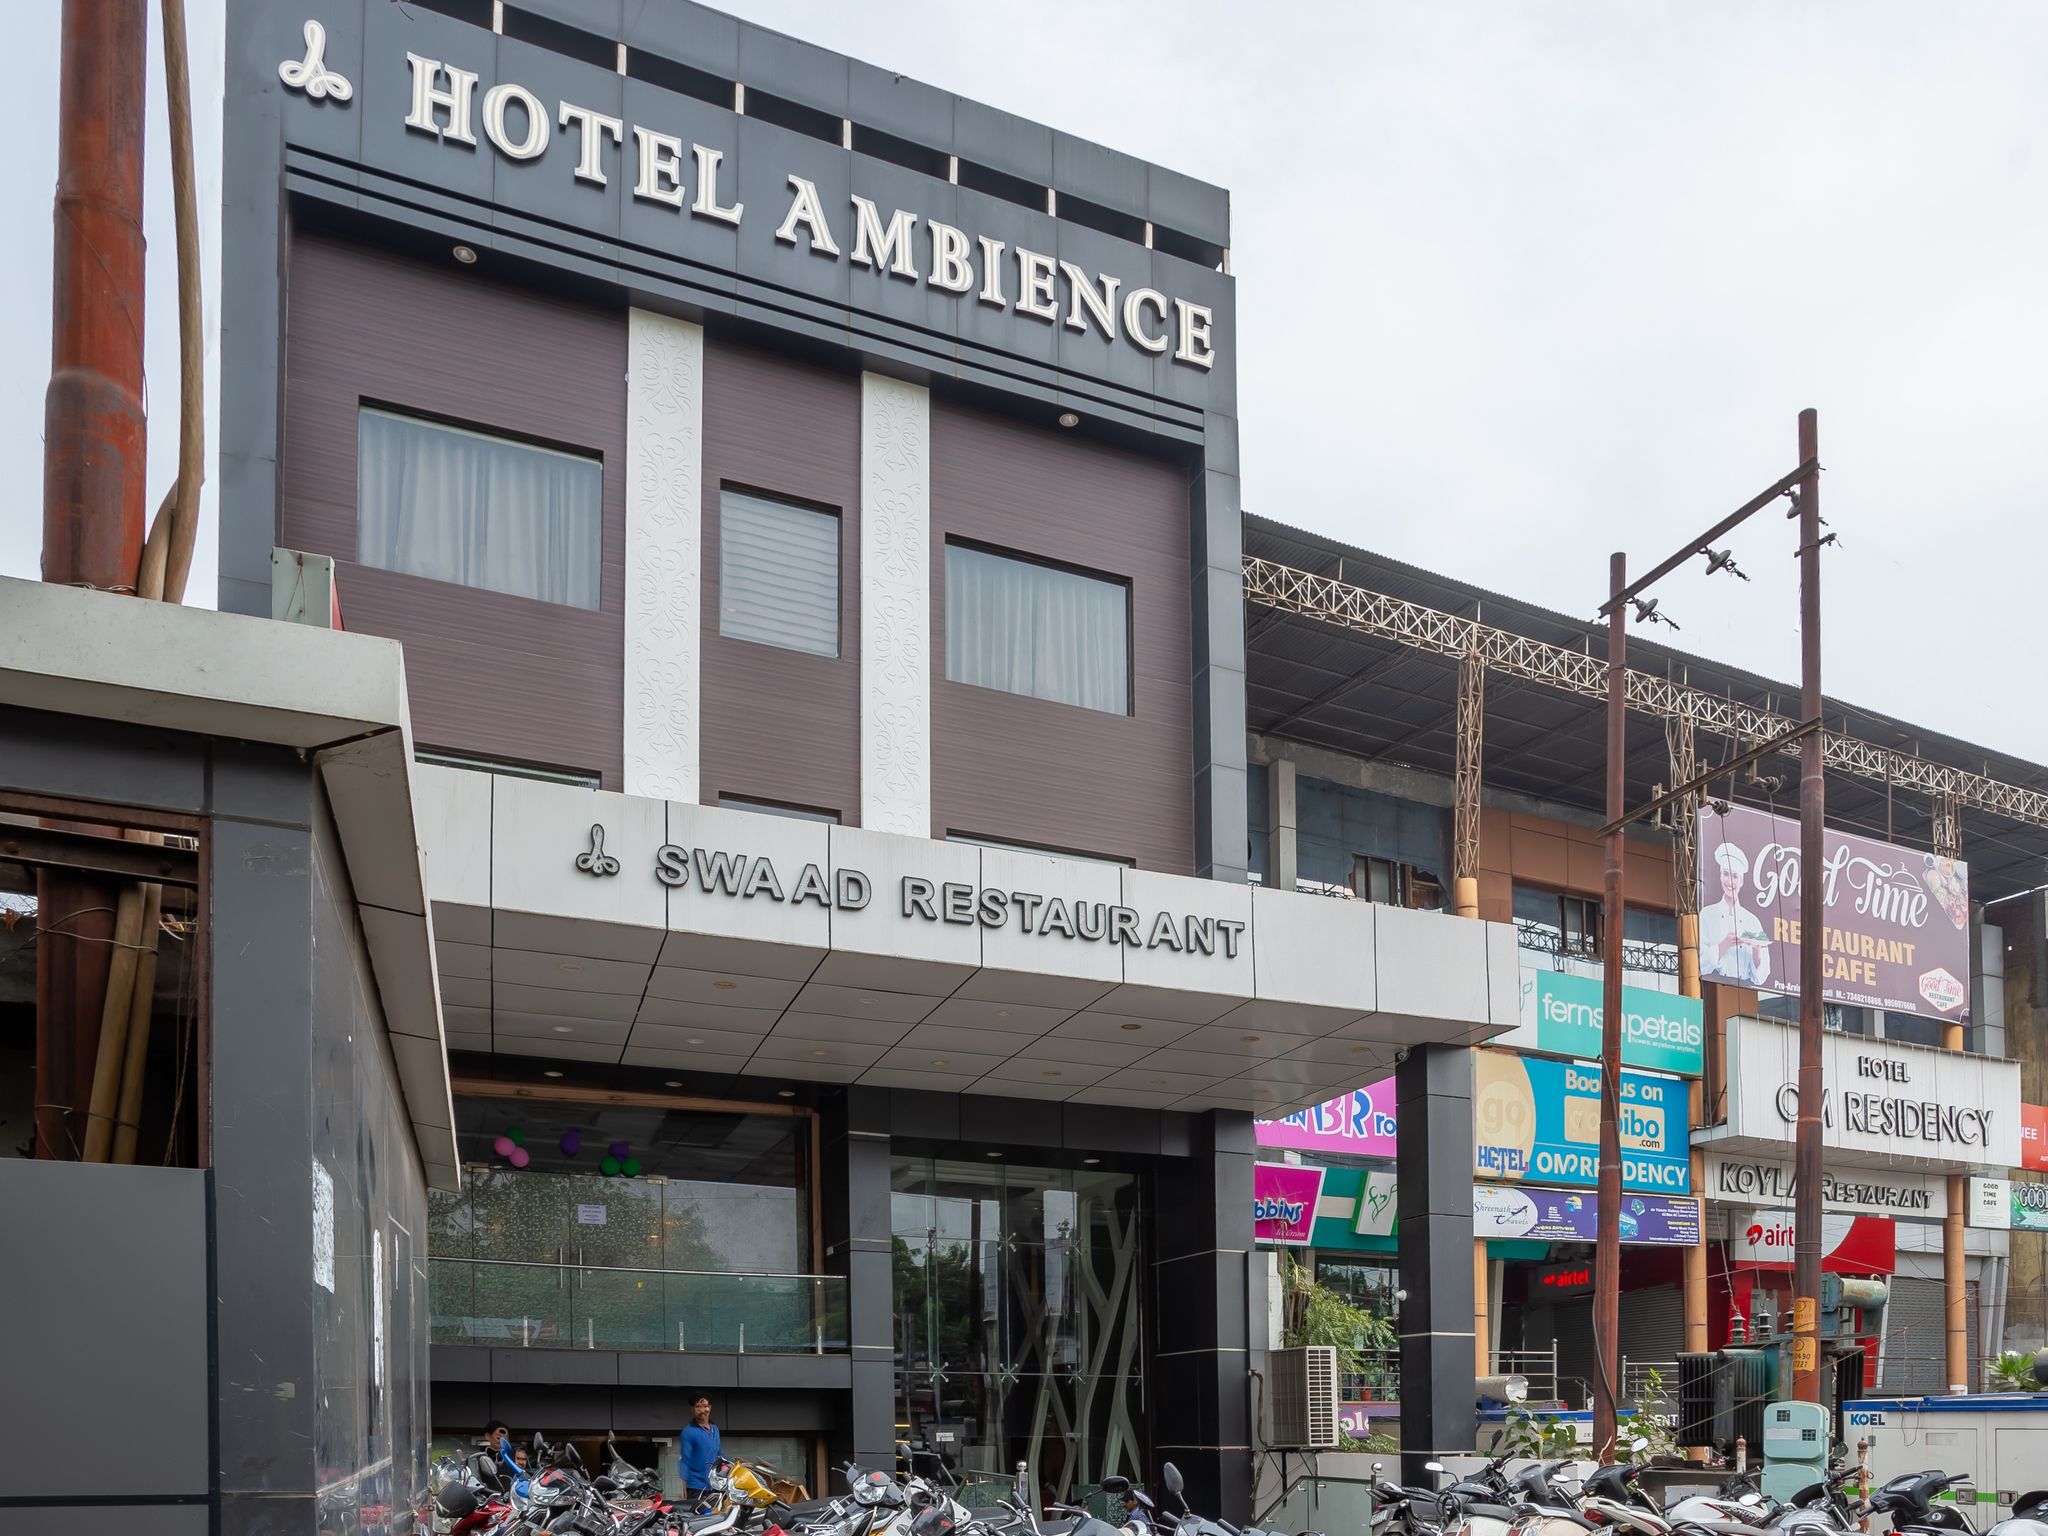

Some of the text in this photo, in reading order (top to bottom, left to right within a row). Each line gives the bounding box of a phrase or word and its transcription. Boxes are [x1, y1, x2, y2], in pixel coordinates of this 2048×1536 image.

[405, 51, 1216, 371] HOTEL AMBIENCE
[655, 844, 1246, 958] SWAAD RESTAURANT
[1753, 843, 1929, 928] God Time
[1773, 916, 1916, 967] RETAURANT
[1822, 953, 1877, 987] CAFE
[1859, 1056, 1911, 1083] HOTEL
[1565, 1069, 1602, 1093] Boo
[1641, 1084, 1663, 1102] on
[1845, 1091, 1994, 1147] RESIDENCY
[1638, 1137, 1660, 1149] .com
[1579, 1156, 1687, 1187] RDENCY
[1983, 1182, 1999, 1190] GOOD
[2019, 1186, 2048, 1209] GOO
[1764, 1223, 1796, 1247] airt
[1557, 1269, 1590, 1288] airtel
[1850, 1413, 1886, 1426] KOEL
